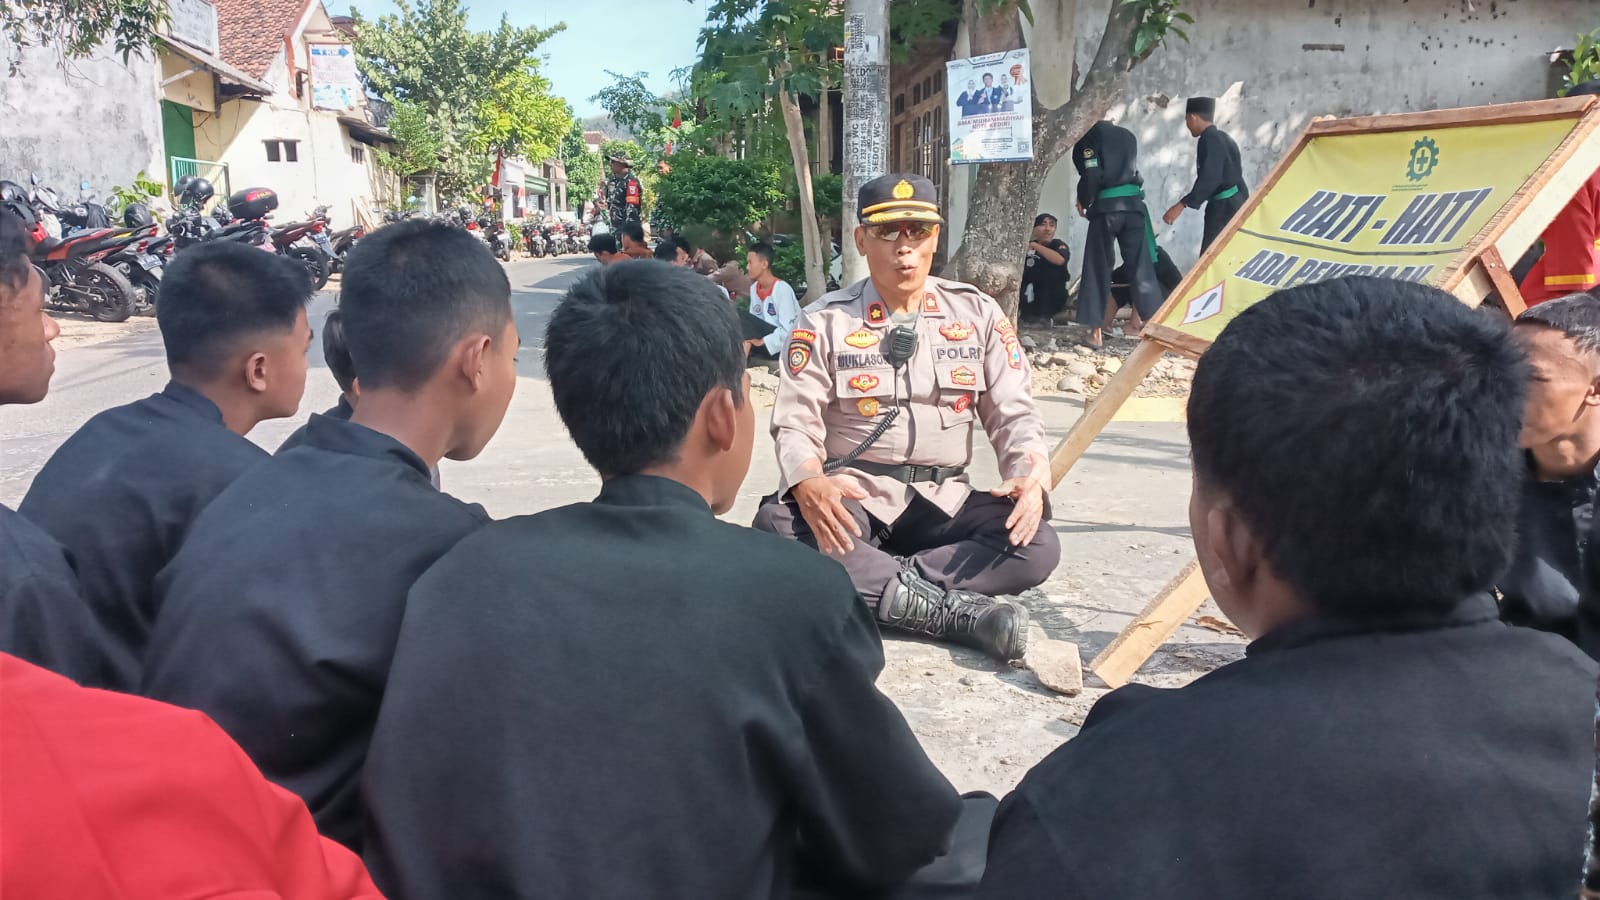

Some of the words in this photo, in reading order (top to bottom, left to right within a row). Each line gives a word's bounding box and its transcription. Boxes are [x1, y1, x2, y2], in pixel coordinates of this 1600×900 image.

[873, 122, 881, 138] WC
[872, 140, 880, 172] SEDOT
[1279, 189, 1388, 244] HATI
[1378, 186, 1495, 246] HATI
[1234, 248, 1300, 289] ADA
[936, 346, 982, 360] POLRI
